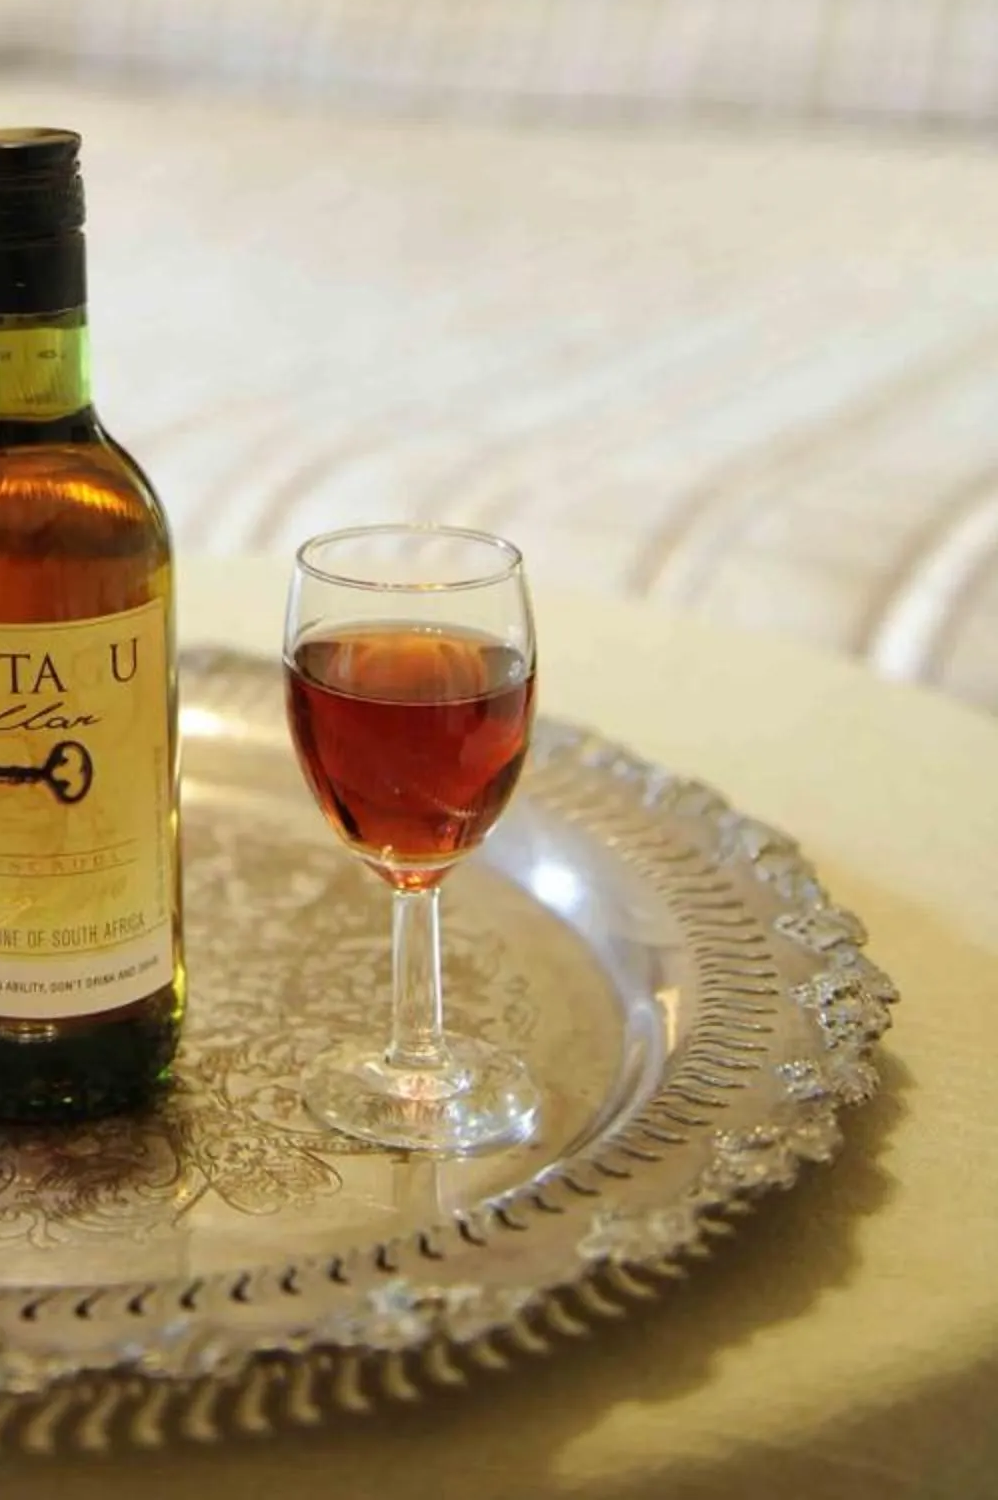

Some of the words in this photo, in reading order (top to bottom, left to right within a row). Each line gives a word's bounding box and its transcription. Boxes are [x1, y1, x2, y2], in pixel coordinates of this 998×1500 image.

[26, 928, 45, 950] OF
[51, 923, 98, 949] SOUTH
[103, 911, 146, 940] AFRICA
